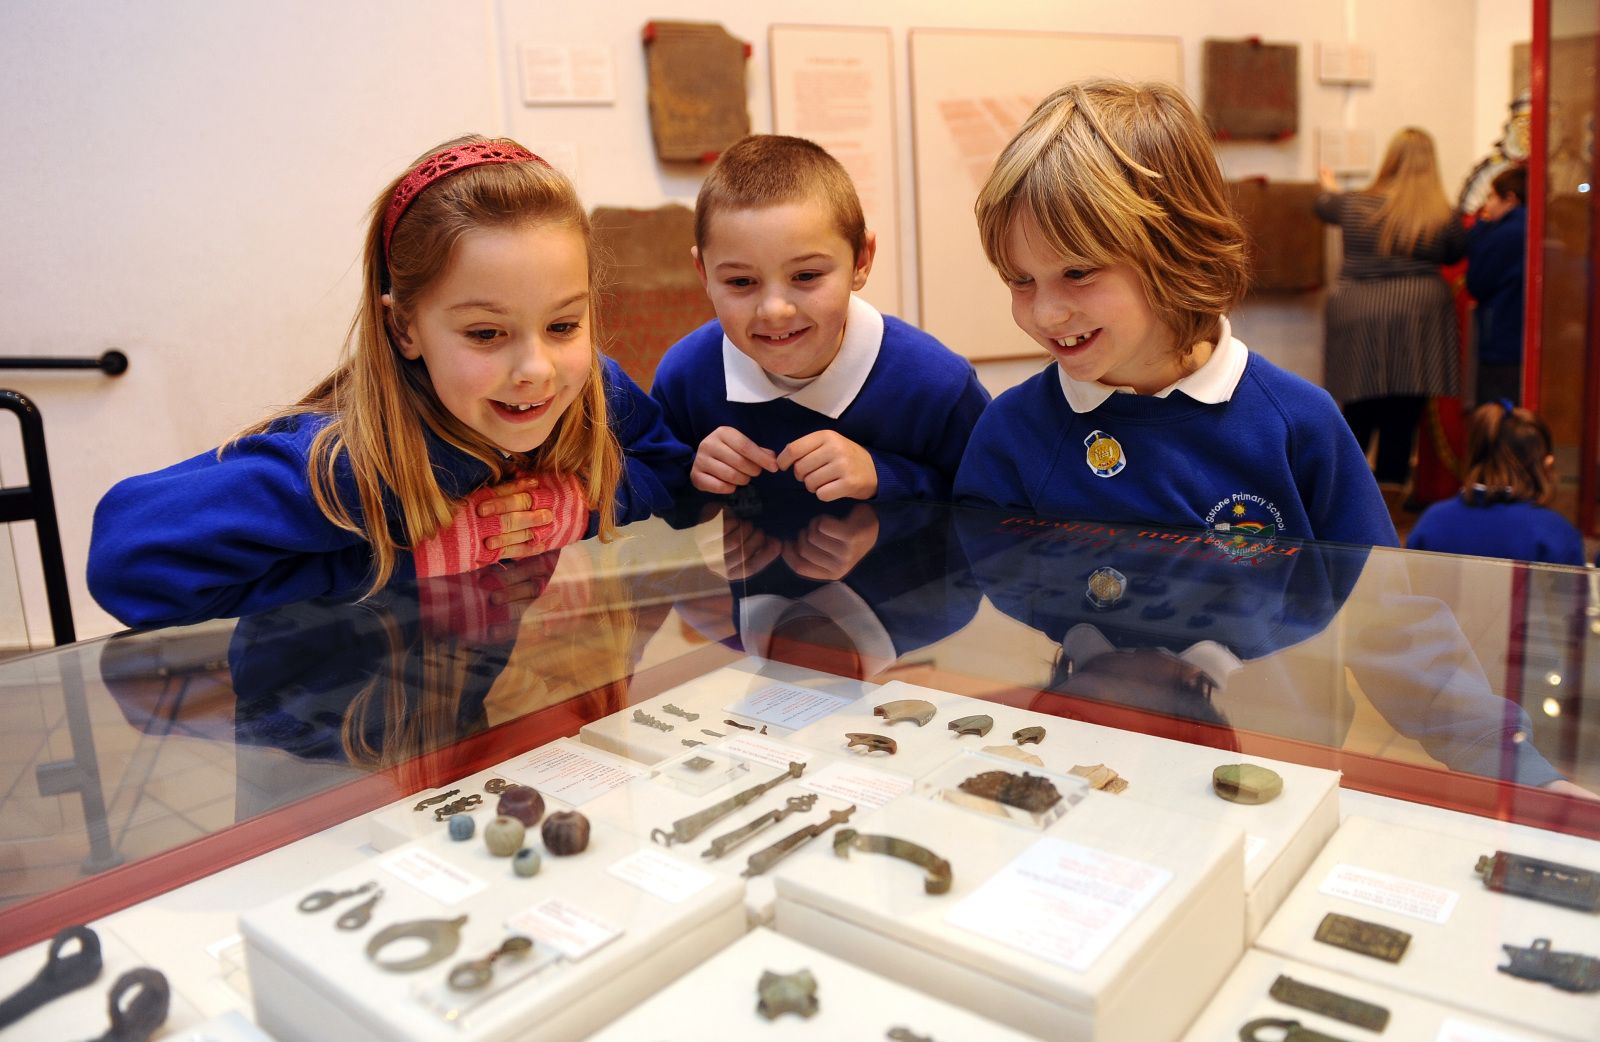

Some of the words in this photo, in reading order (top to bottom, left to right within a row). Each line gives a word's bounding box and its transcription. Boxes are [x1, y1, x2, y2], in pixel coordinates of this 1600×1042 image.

[1205, 497, 1231, 524] gstone
[1232, 491, 1266, 506] Primary
[1266, 501, 1287, 532] School
